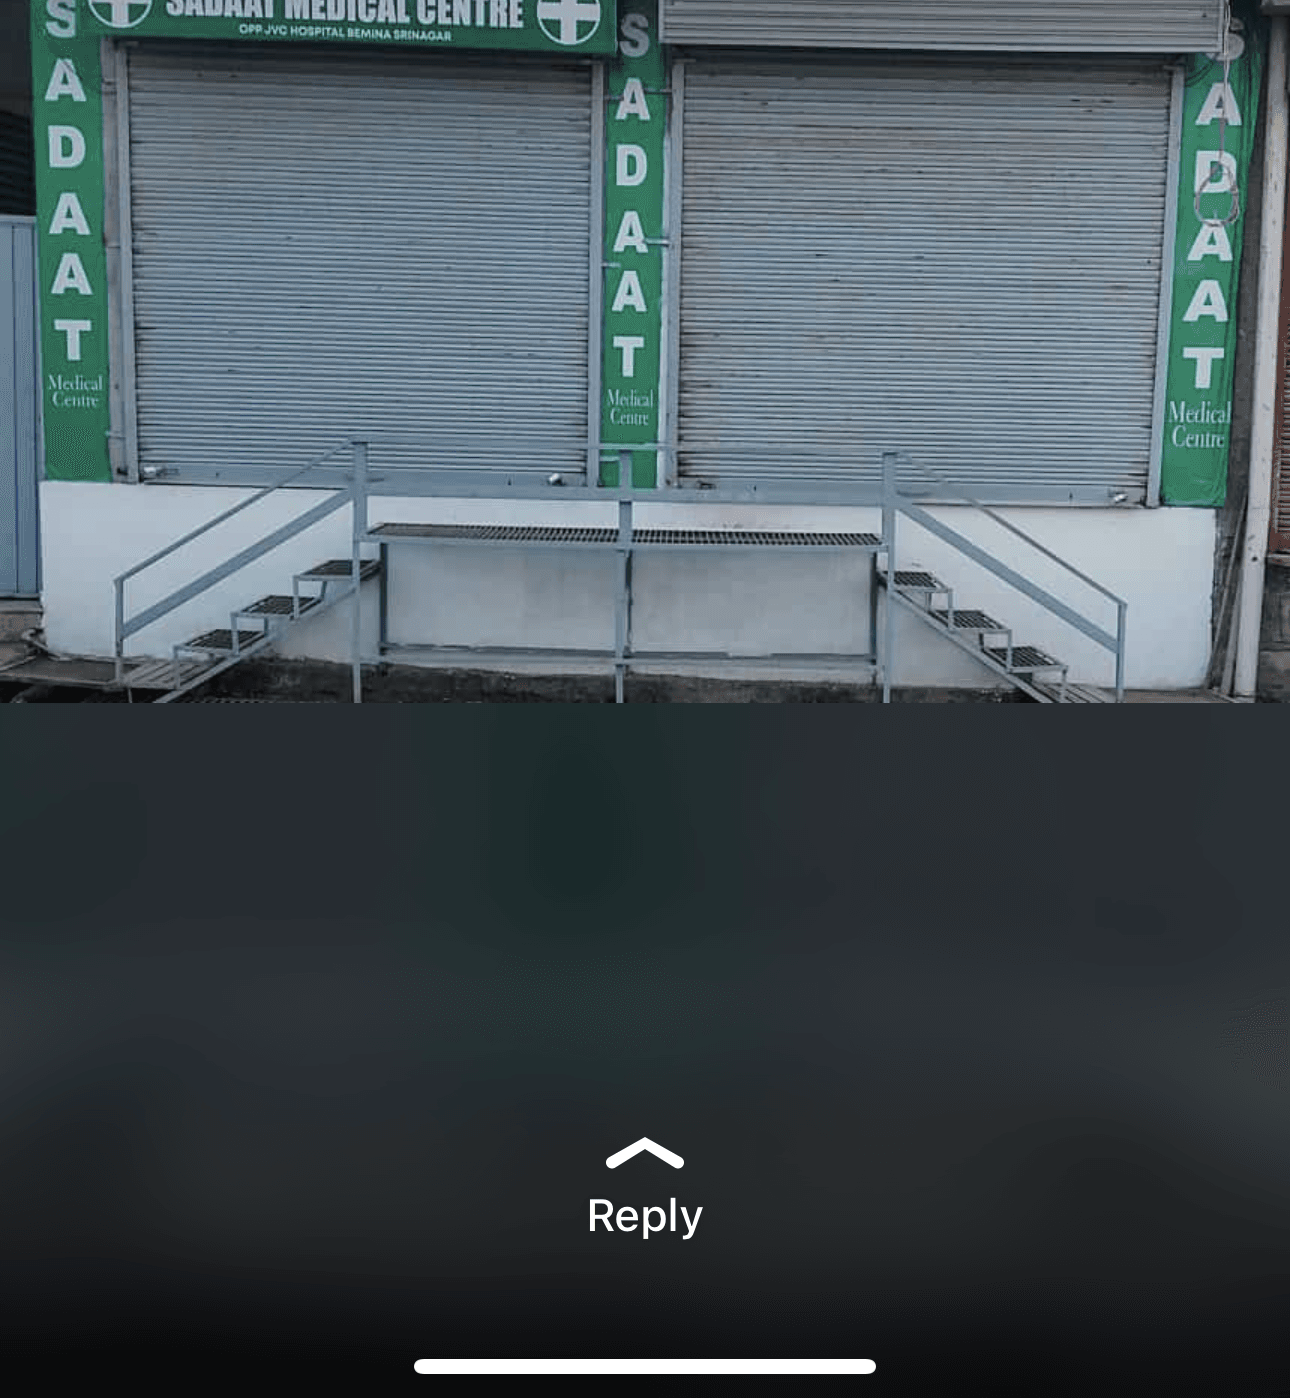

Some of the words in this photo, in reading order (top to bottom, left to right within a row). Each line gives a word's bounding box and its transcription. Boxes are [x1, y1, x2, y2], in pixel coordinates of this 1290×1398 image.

[264, 24, 287, 36] JVC
[290, 26, 344, 38] HOSPITAL
[347, 29, 391, 40] BEMINA
[393, 30, 452, 42] SRINAGAR
[610, 12, 652, 378] SADAAT
[47, 374, 103, 391] Medical
[52, 391, 100, 408] Centre
[607, 388, 654, 408] Medical
[610, 407, 649, 426] Centre
[1168, 400, 1232, 424] Medical
[1172, 424, 1225, 448] Centre
